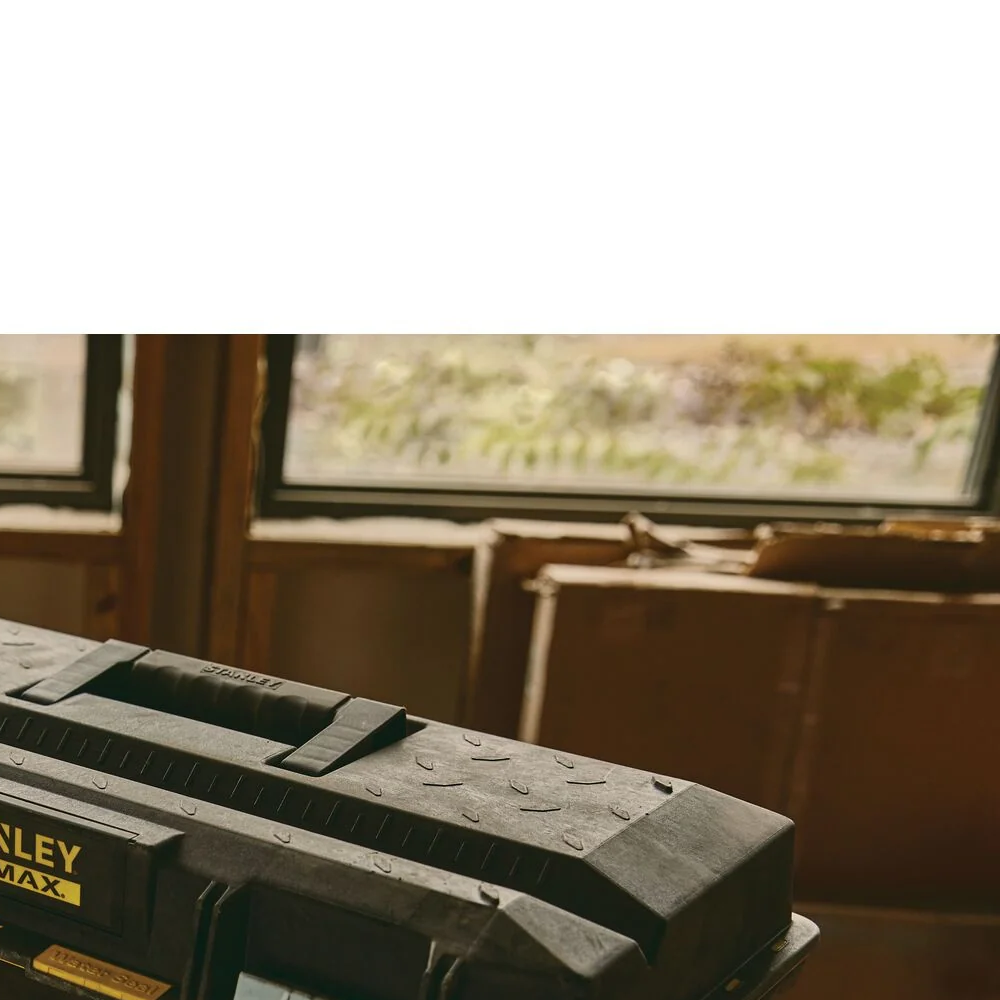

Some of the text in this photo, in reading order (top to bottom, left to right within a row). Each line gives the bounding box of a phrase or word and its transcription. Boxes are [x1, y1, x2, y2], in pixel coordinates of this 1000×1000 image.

[201, 664, 283, 690] STANLEY
[50, 950, 160, 995] Water Seal
